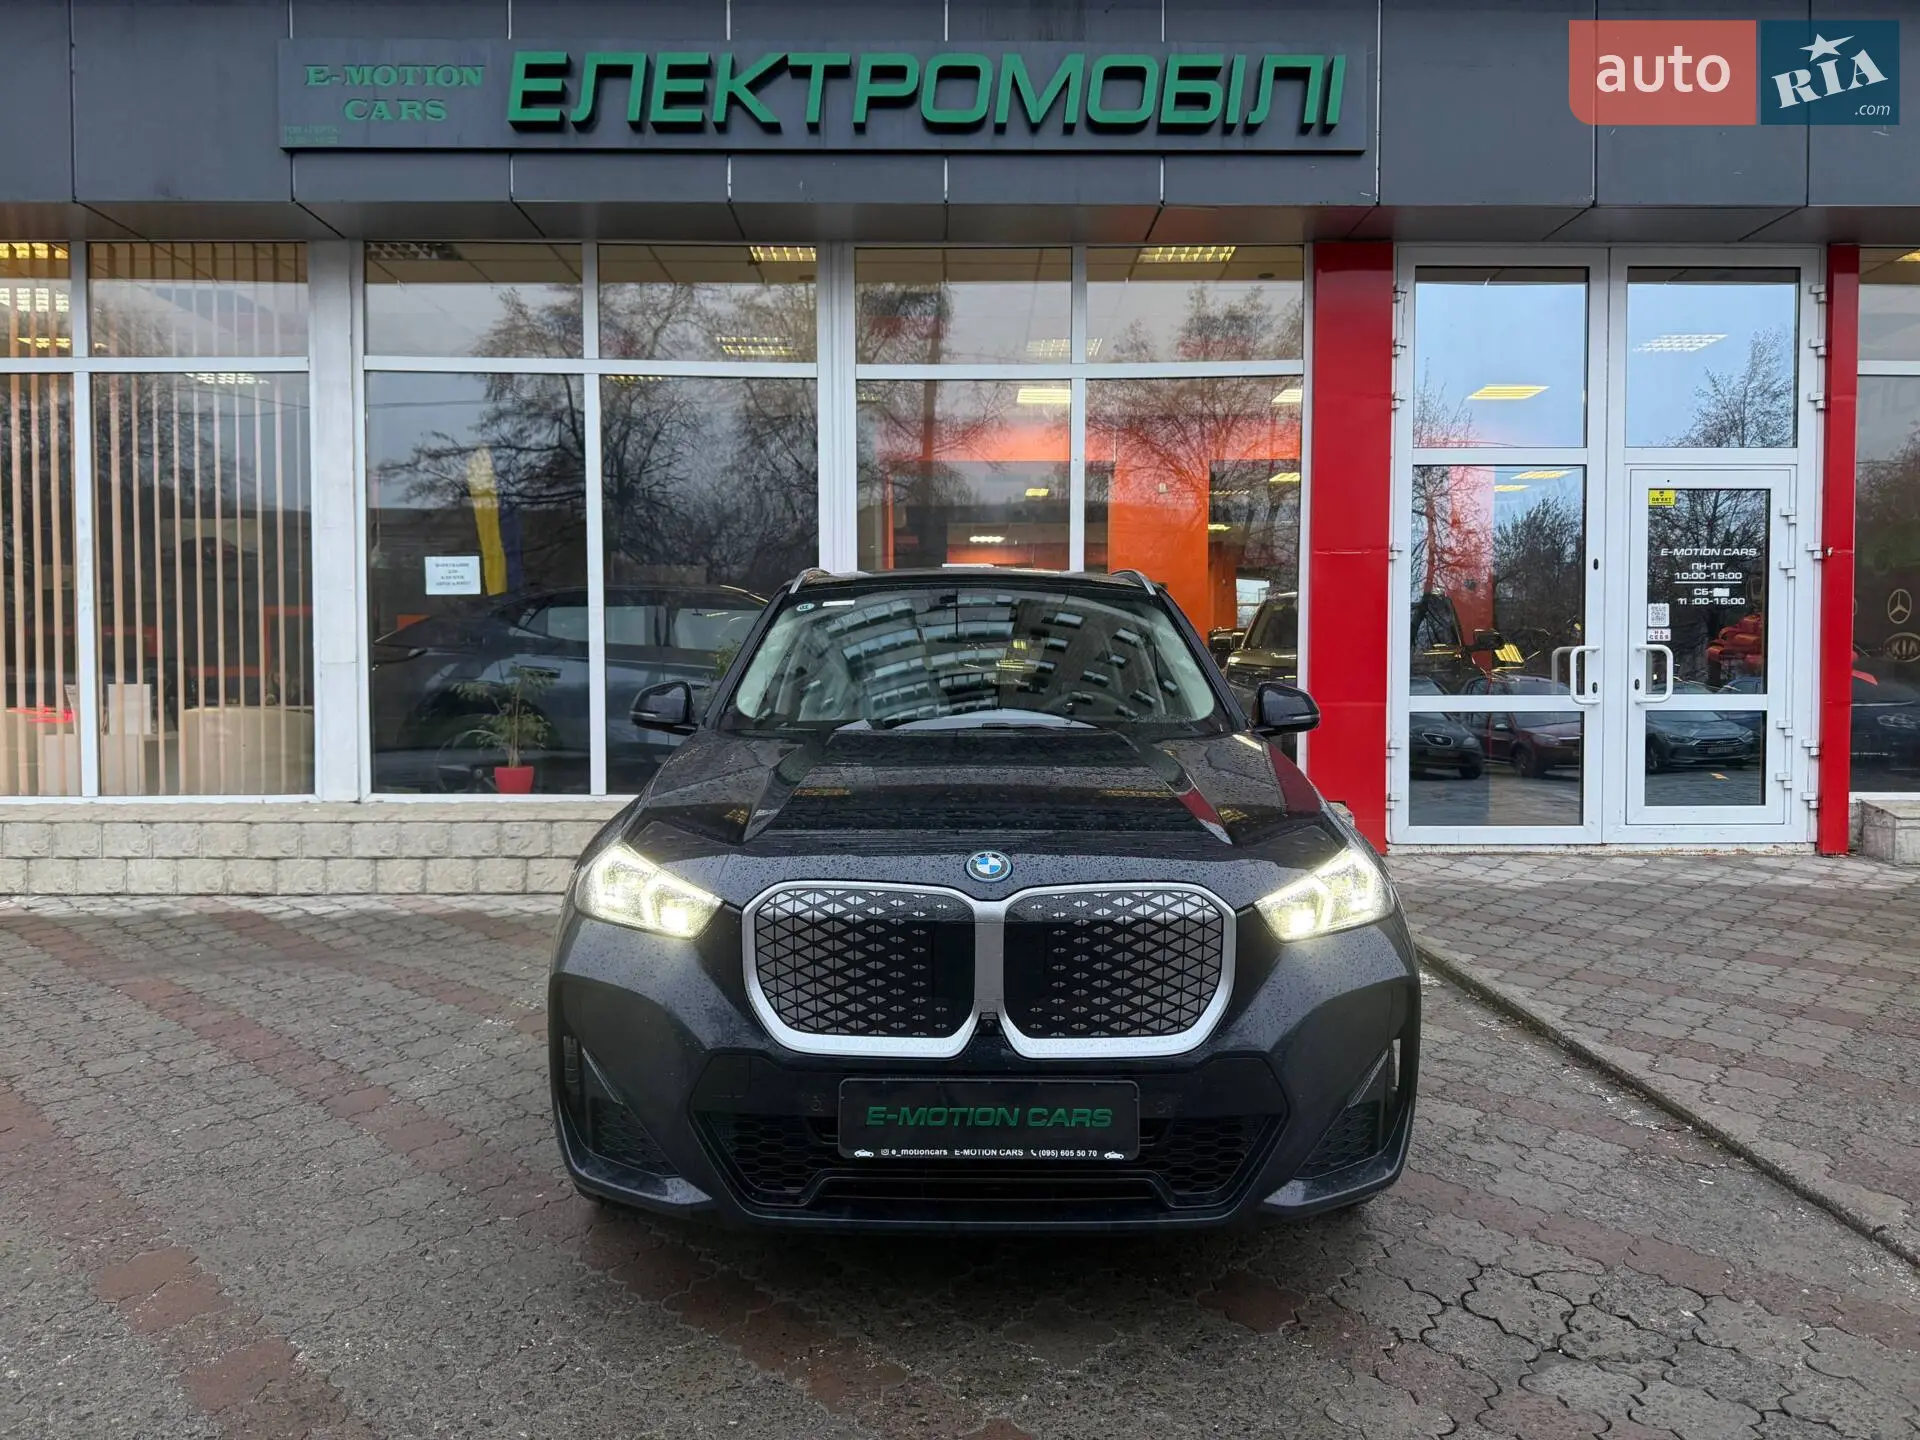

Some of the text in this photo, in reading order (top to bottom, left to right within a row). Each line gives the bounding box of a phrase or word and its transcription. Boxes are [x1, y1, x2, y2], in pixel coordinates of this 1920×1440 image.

[305, 65, 485, 87] E-MOTION
[508, 51, 1346, 127] ЕЛЕКТРОМОБІЛІ
[343, 98, 448, 121] CARS
[1660, 548, 1757, 556] E-MOTION CARS
[1691, 562, 1725, 570] ПН-ПТ
[1674, 572, 1742, 580] 10:00-19:00
[866, 1106, 1113, 1128] E-MOTION CARS
[1088, 1149, 1098, 1157] 70
